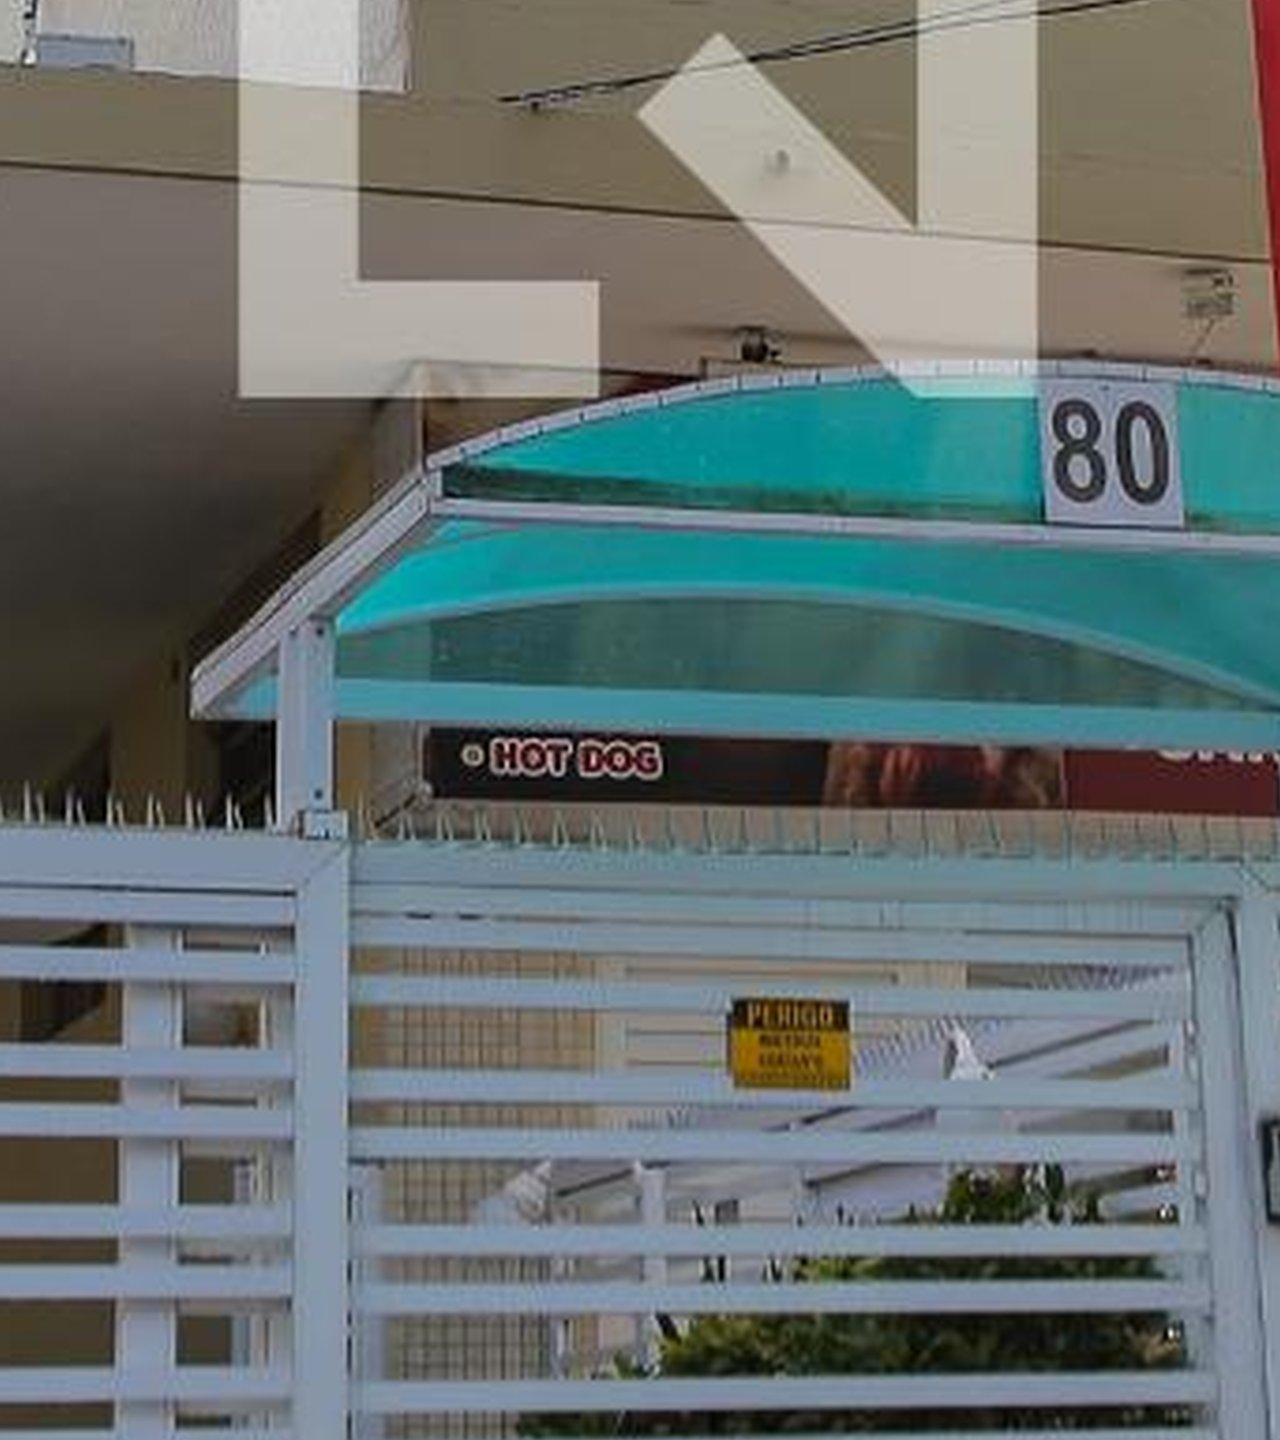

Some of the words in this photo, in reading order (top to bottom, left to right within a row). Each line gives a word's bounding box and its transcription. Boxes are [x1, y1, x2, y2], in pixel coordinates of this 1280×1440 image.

[1051, 399, 1170, 507] 80
[490, 737, 573, 778] HOT
[577, 740, 663, 780] DOG
